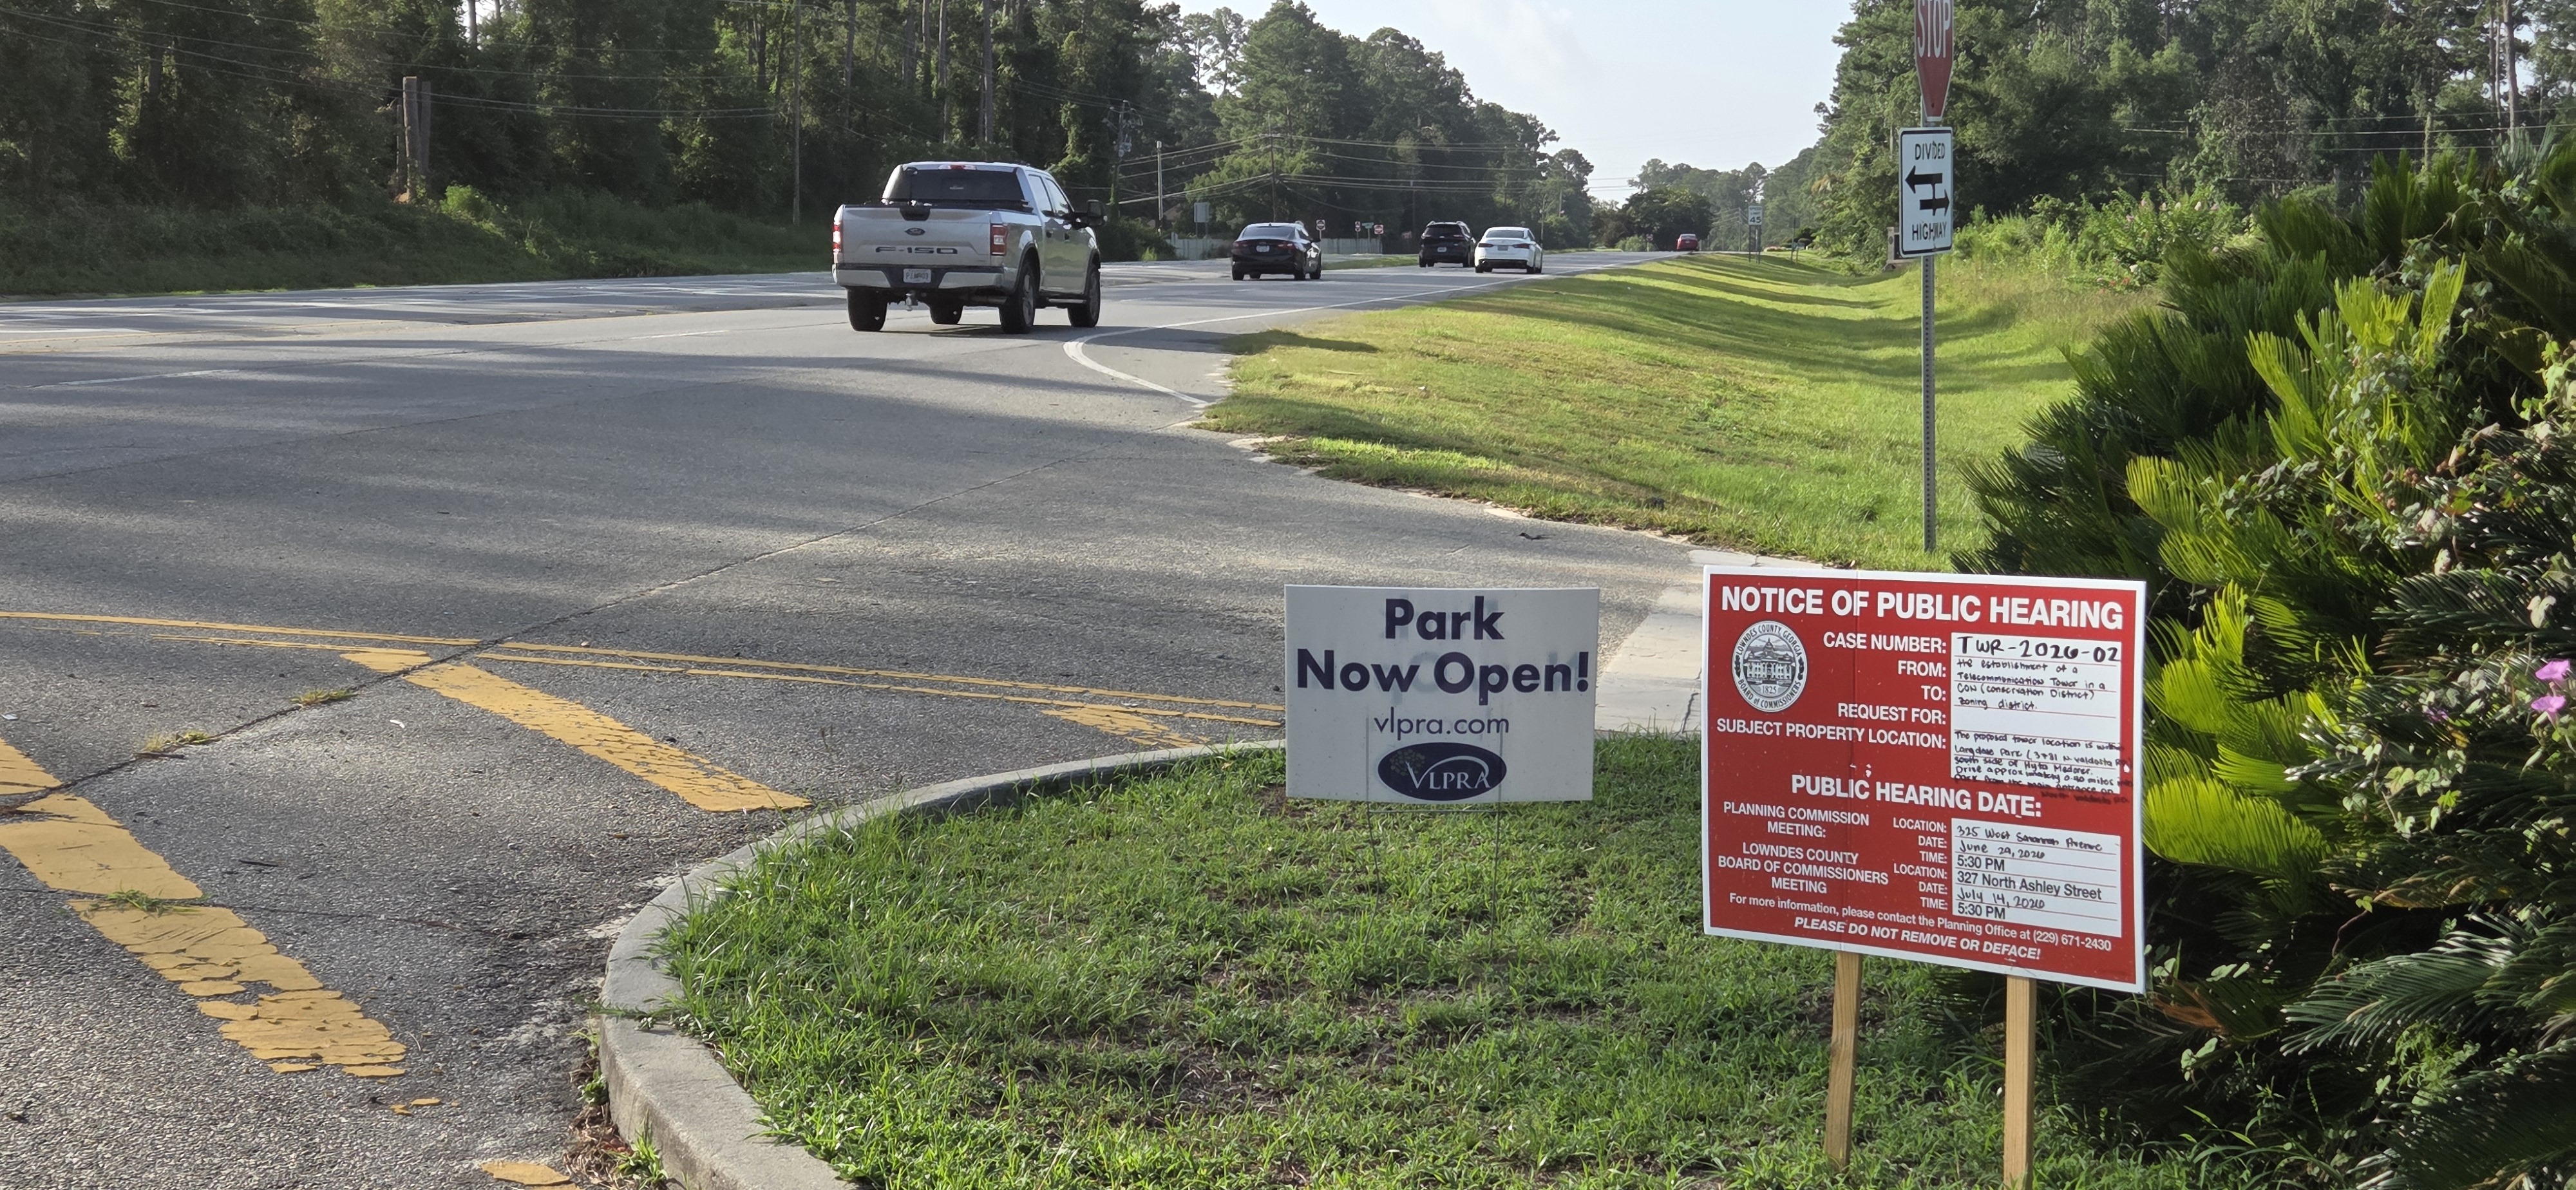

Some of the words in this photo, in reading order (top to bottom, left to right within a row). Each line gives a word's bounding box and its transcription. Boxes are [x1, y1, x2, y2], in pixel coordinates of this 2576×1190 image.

[1917, 0, 1952, 57] STOP
[1915, 142, 1946, 160] DIVIDED
[1911, 222, 1947, 241] HIGHWAY
[1385, 596, 1506, 641] Park
[1721, 587, 1823, 614] NOTICE
[1831, 590, 1869, 616] OF
[1877, 593, 1981, 623] PUBLIC
[1989, 596, 2123, 630] HEARING
[1736, 628, 1757, 656] LOWNDES
[1783, 630, 1802, 657] GEORGIA
[1823, 632, 1867, 649] CASE
[1871, 634, 1946, 654] NUMBER:
[1956, 636, 2121, 663] TWR-2026-02
[1296, 648, 1420, 692] Now
[1434, 652, 1589, 706] Open!
[1898, 660, 1946, 677] FROM:
[1738, 679, 1754, 700] BOARD
[1760, 681, 1801, 708] COMMISSIONERS
[1762, 686, 1777, 694] 1825
[1921, 685, 1946, 701] TO:
[2085, 680, 2094, 688] in
[1373, 707, 1510, 741] vlpra.com
[1838, 703, 1908, 722] REQUEST
[1911, 708, 1946, 725] FOR:
[1716, 718, 1782, 736] SUBJECT
[1786, 722, 1865, 742] PROPERTY
[1868, 728, 1946, 749] LOCATION:
[2042, 737, 2081, 748] location
[1405, 760, 1492, 790] VLPRA
[1792, 775, 1870, 799] PUBLIC
[1876, 781, 1971, 810] HEARING
[1978, 790, 2041, 817] DATE:
[1723, 801, 1785, 818] PLANNING
[1788, 807, 1869, 826] COMMISSION
[1767, 820, 1826, 838] MEETING:
[1893, 817, 1947, 833] LOCATION:
[1957, 825, 1981, 837] 325
[1918, 835, 1947, 849] DATE:
[1960, 840, 1989, 853] June
[1743, 842, 1803, 859] LOWNDES
[1806, 848, 1859, 865] COUNTY
[1919, 851, 1947, 864] TIME:
[1957, 855, 1982, 869] 5:30
[1985, 858, 2005, 871] PM
[1718, 855, 1761, 870] BOARD
[1763, 859, 1780, 872] OF
[1783, 861, 1889, 885] COMMISSIONERS
[1893, 863, 1947, 880] LOCATION:
[1771, 876, 1827, 894] MEETING
[1918, 881, 1947, 894] DATE:
[1957, 871, 1978, 884] 327
[1982, 873, 2016, 889] North
[2019, 878, 2060, 897] Ashley
[2064, 883, 2101, 900] Street
[1920, 896, 1947, 911] TIME:
[1957, 887, 1983, 903] July
[1993, 893, 2010, 909] 14,
[1729, 892, 1747, 904] For
[1749, 896, 1775, 907] more
[1777, 897, 1839, 916] information,
[1842, 905, 1875, 920] please
[1877, 911, 1916, 925] contact
[1918, 915, 1935, 927] the
[1937, 918, 1982, 936] Planning
[1984, 923, 2016, 938] Office
[2020, 929, 2031, 940] at
[2033, 930, 2058, 946] (229)
[2061, 935, 2112, 952] 671-2430
[1958, 902, 1982, 916] 5:30
[1985, 905, 2005, 920] PM
[1795, 917, 1845, 933] PLEASE
[1848, 923, 1868, 936] DO
[1871, 926, 1899, 940] NOT
[1901, 929, 1956, 948] REMOVE
[1960, 938, 1980, 950] OR
[1982, 941, 2041, 959] DEFACE!
